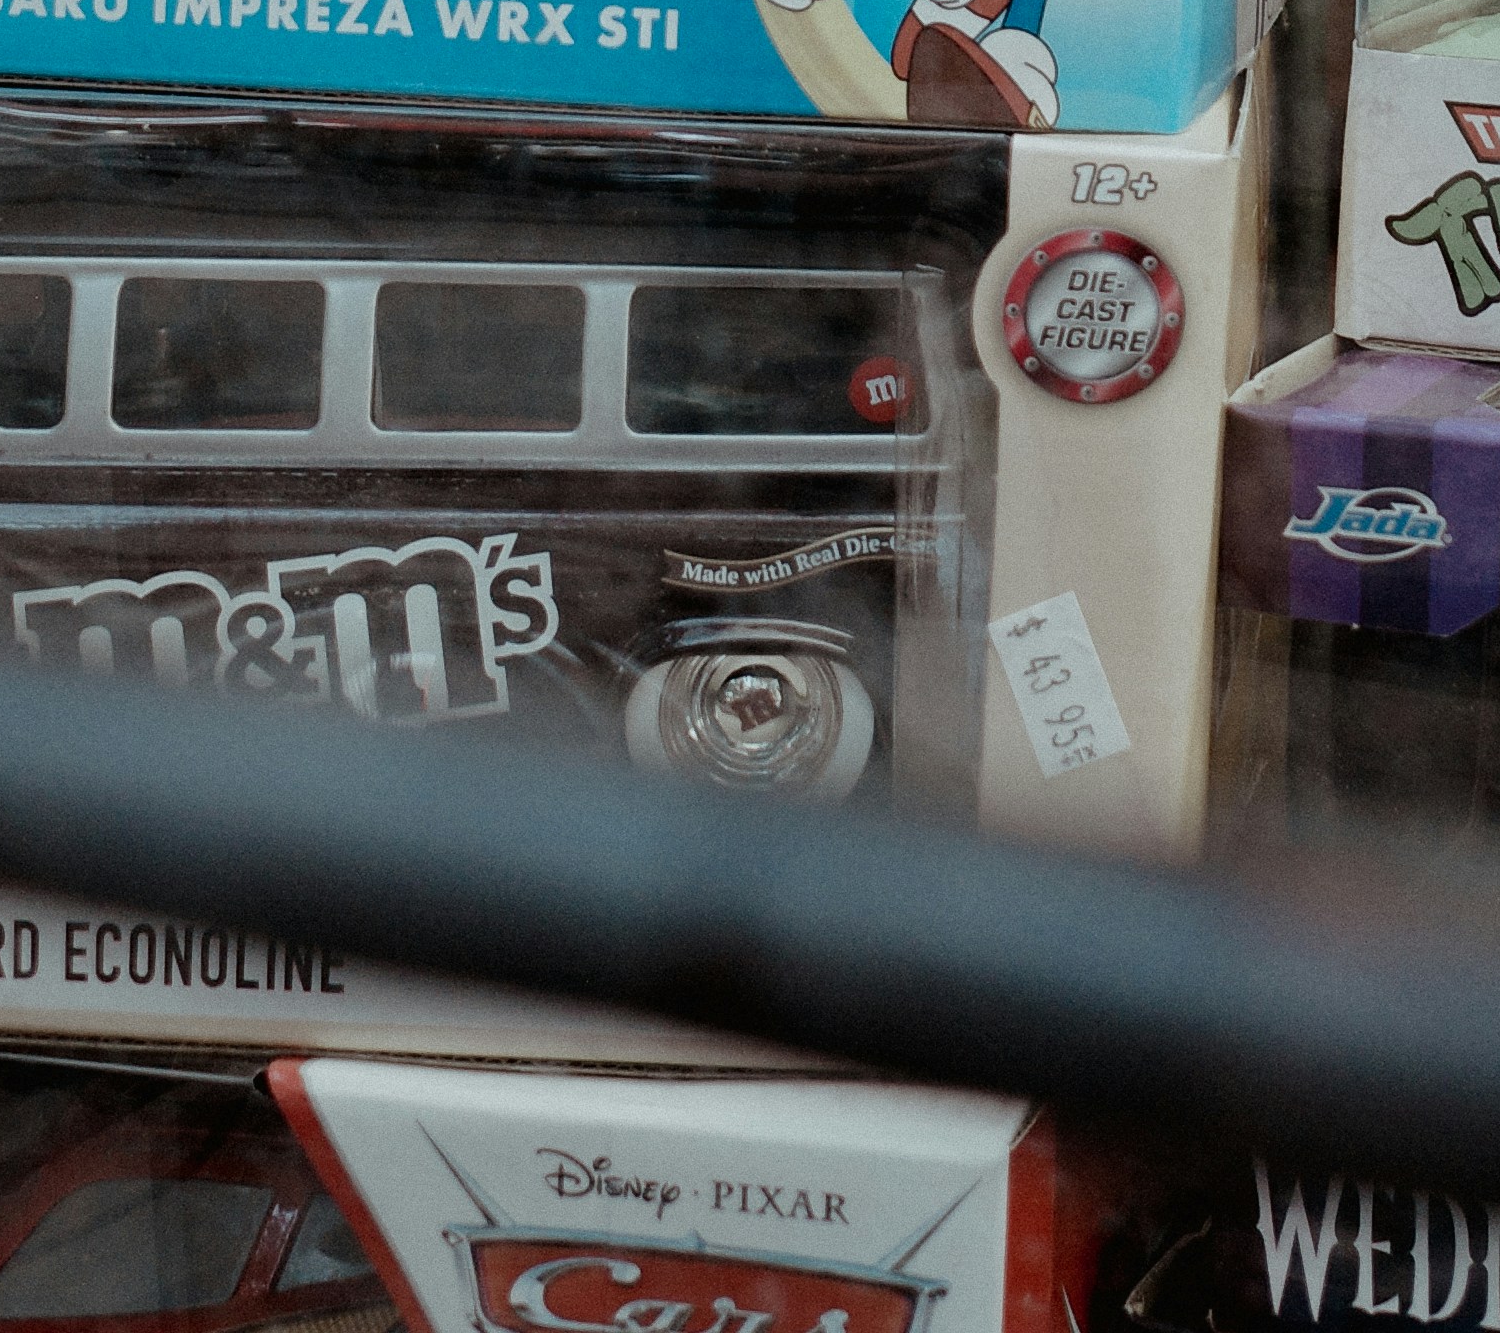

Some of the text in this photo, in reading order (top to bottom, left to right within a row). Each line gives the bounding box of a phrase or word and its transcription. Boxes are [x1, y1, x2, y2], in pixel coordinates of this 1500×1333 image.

[597, 6, 679, 50] STI
[1070, 162, 1157, 205] 12+
[1066, 270, 1127, 294] DIE-
[1054, 297, 1136, 324] CAST
[1038, 325, 1148, 354] FIGURE
[1284, 487, 1445, 544] Jada
[681, 561, 740, 585] Made
[743, 561, 793, 585] with
[794, 545, 842, 574] Real
[536, 1148, 849, 1225] Disney PIXAR
